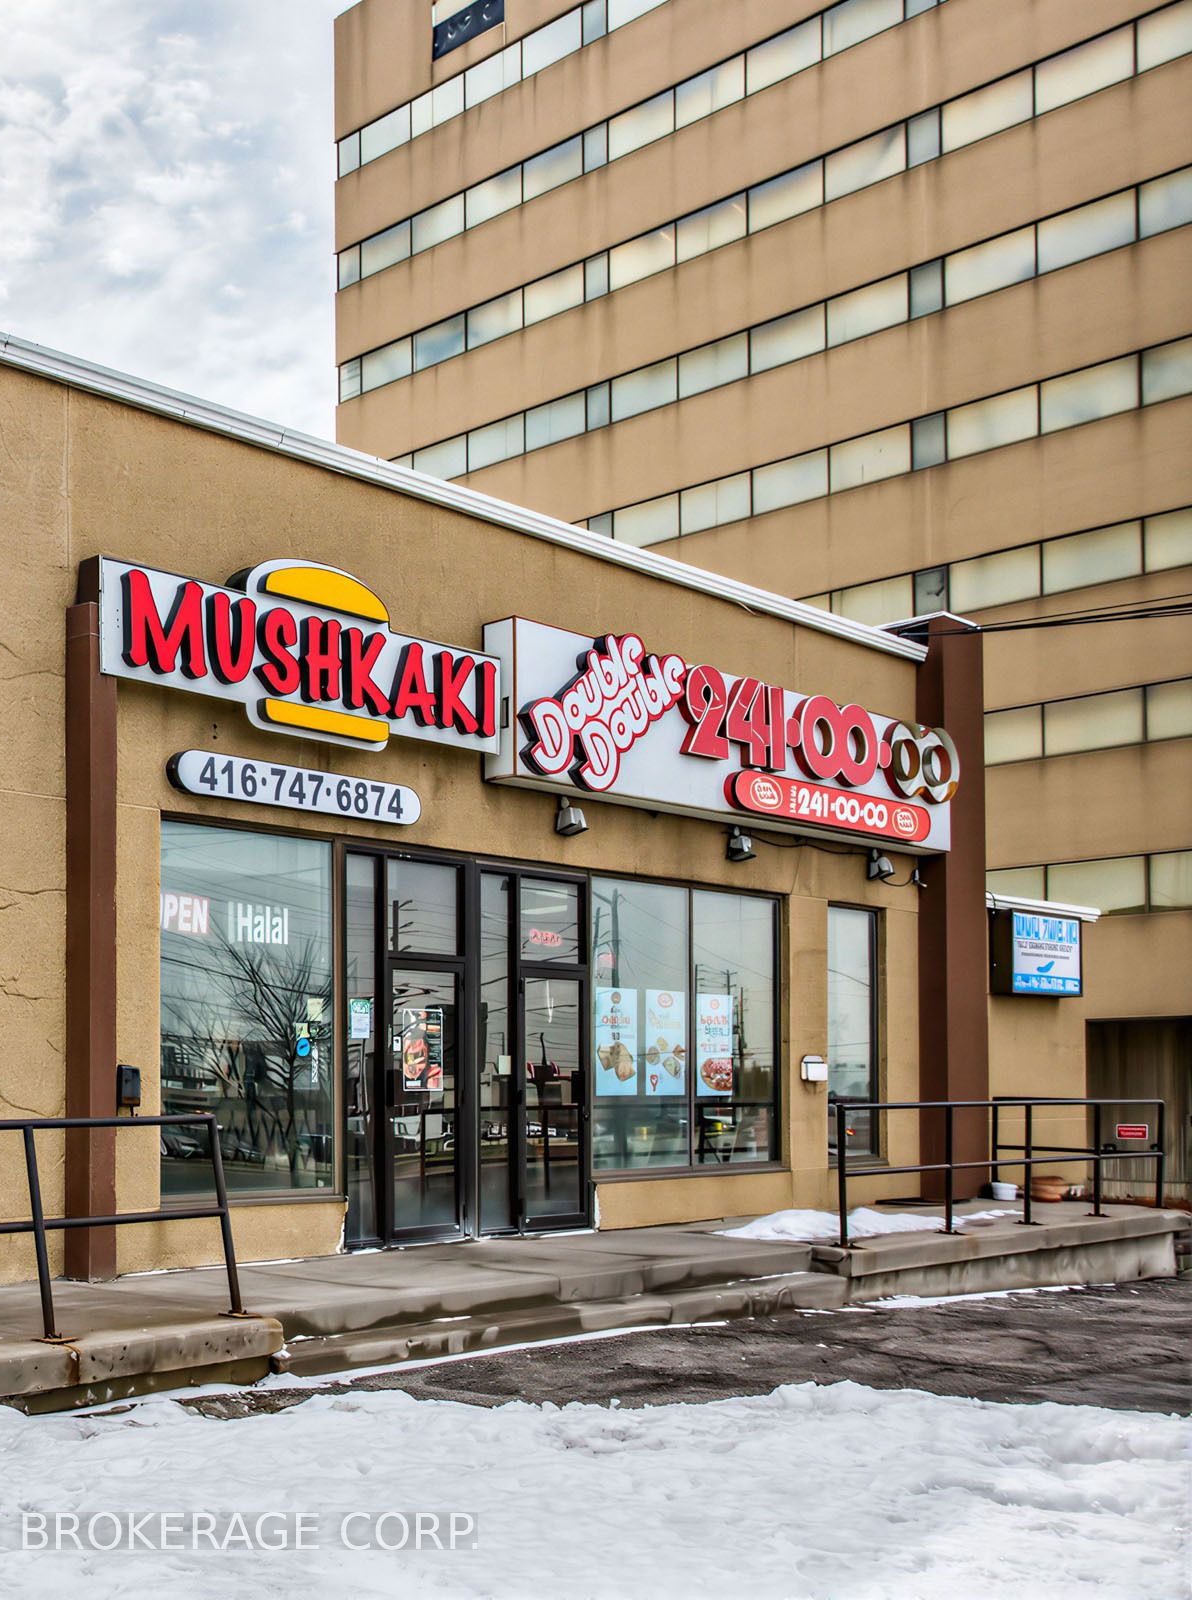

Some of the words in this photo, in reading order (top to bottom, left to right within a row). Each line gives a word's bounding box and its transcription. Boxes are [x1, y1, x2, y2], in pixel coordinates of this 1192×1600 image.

[121, 569, 497, 738] MUSHKAKI
[529, 633, 646, 774] Double
[578, 654, 687, 792] Double
[159, 893, 208, 934] PEN
[237, 902, 289, 945] Halal
